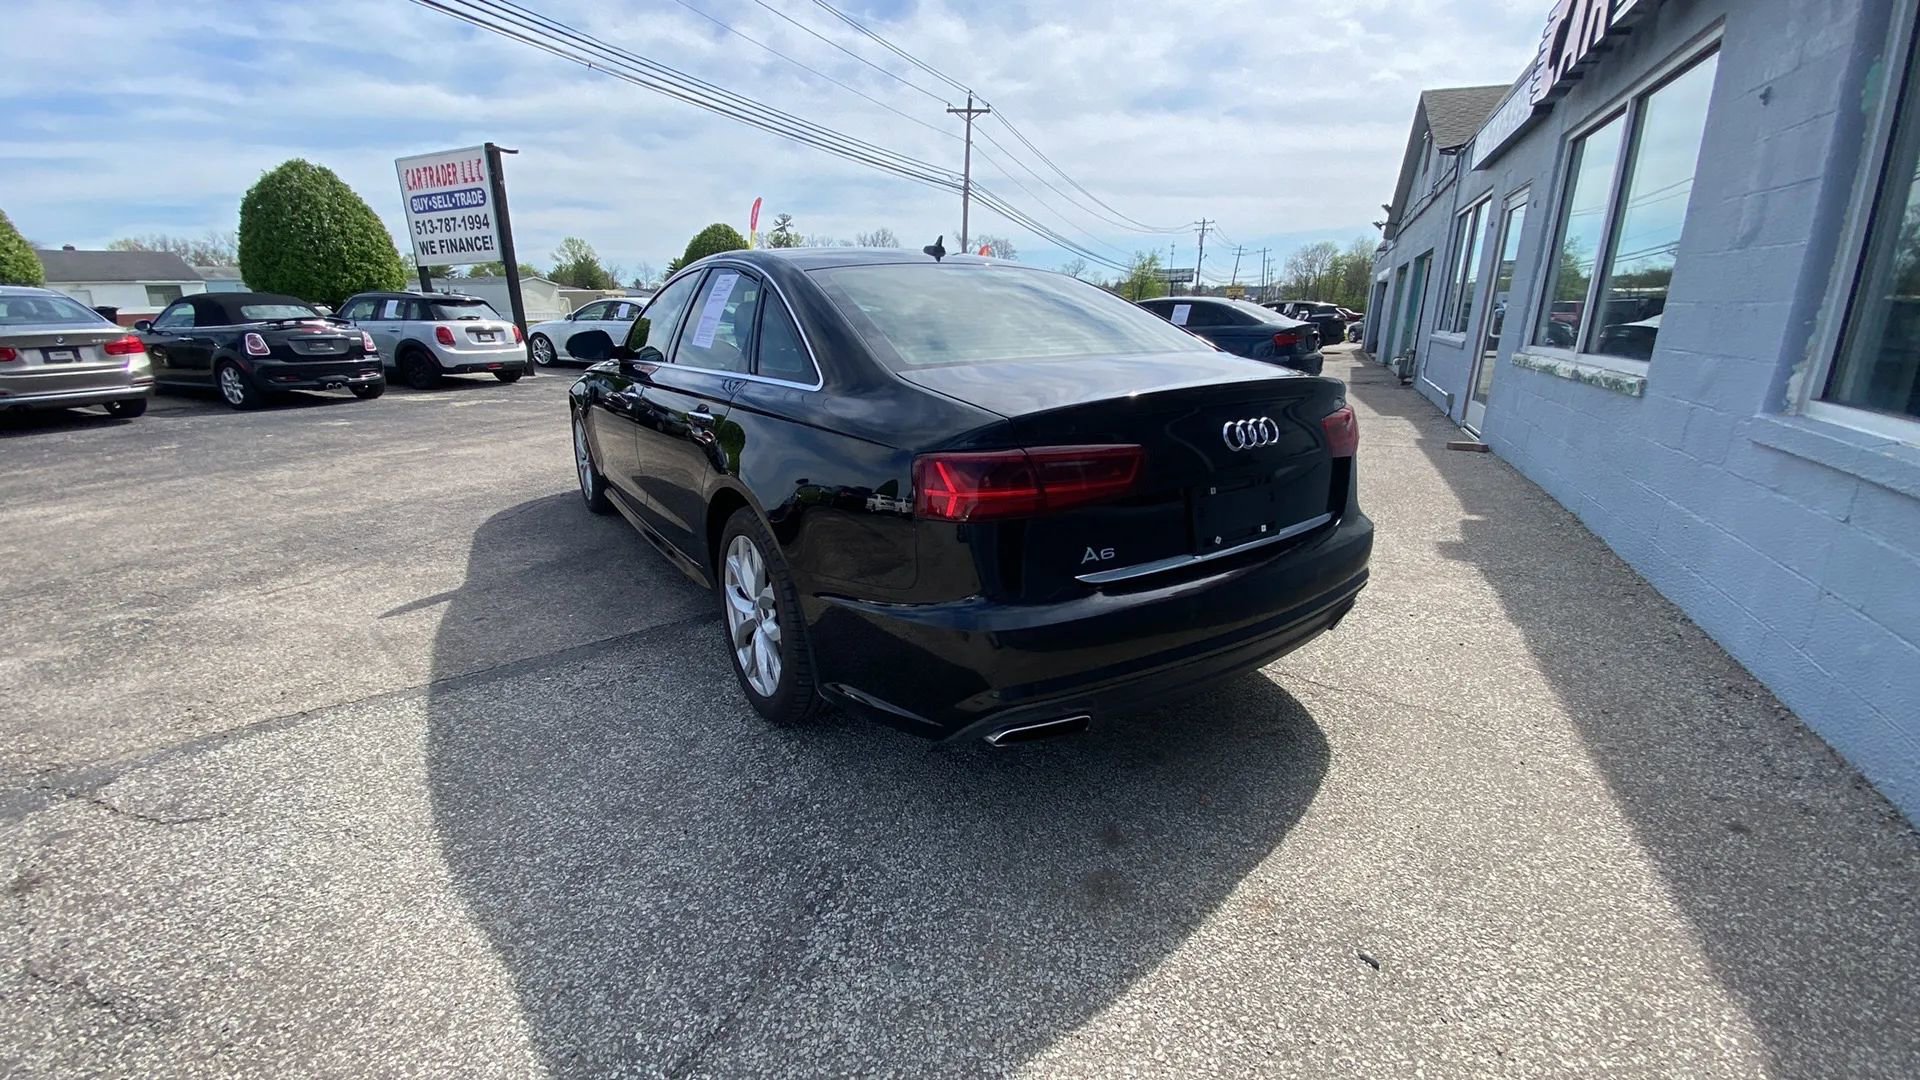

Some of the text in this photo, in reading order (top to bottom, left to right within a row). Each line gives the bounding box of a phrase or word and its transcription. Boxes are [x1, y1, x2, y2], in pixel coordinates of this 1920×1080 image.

[405, 158, 484, 191] CARTRADER LLC
[415, 214, 490, 235] 513-787-1994
[418, 235, 494, 255] WE FINANCE!
[1080, 546, 1115, 565] A6
